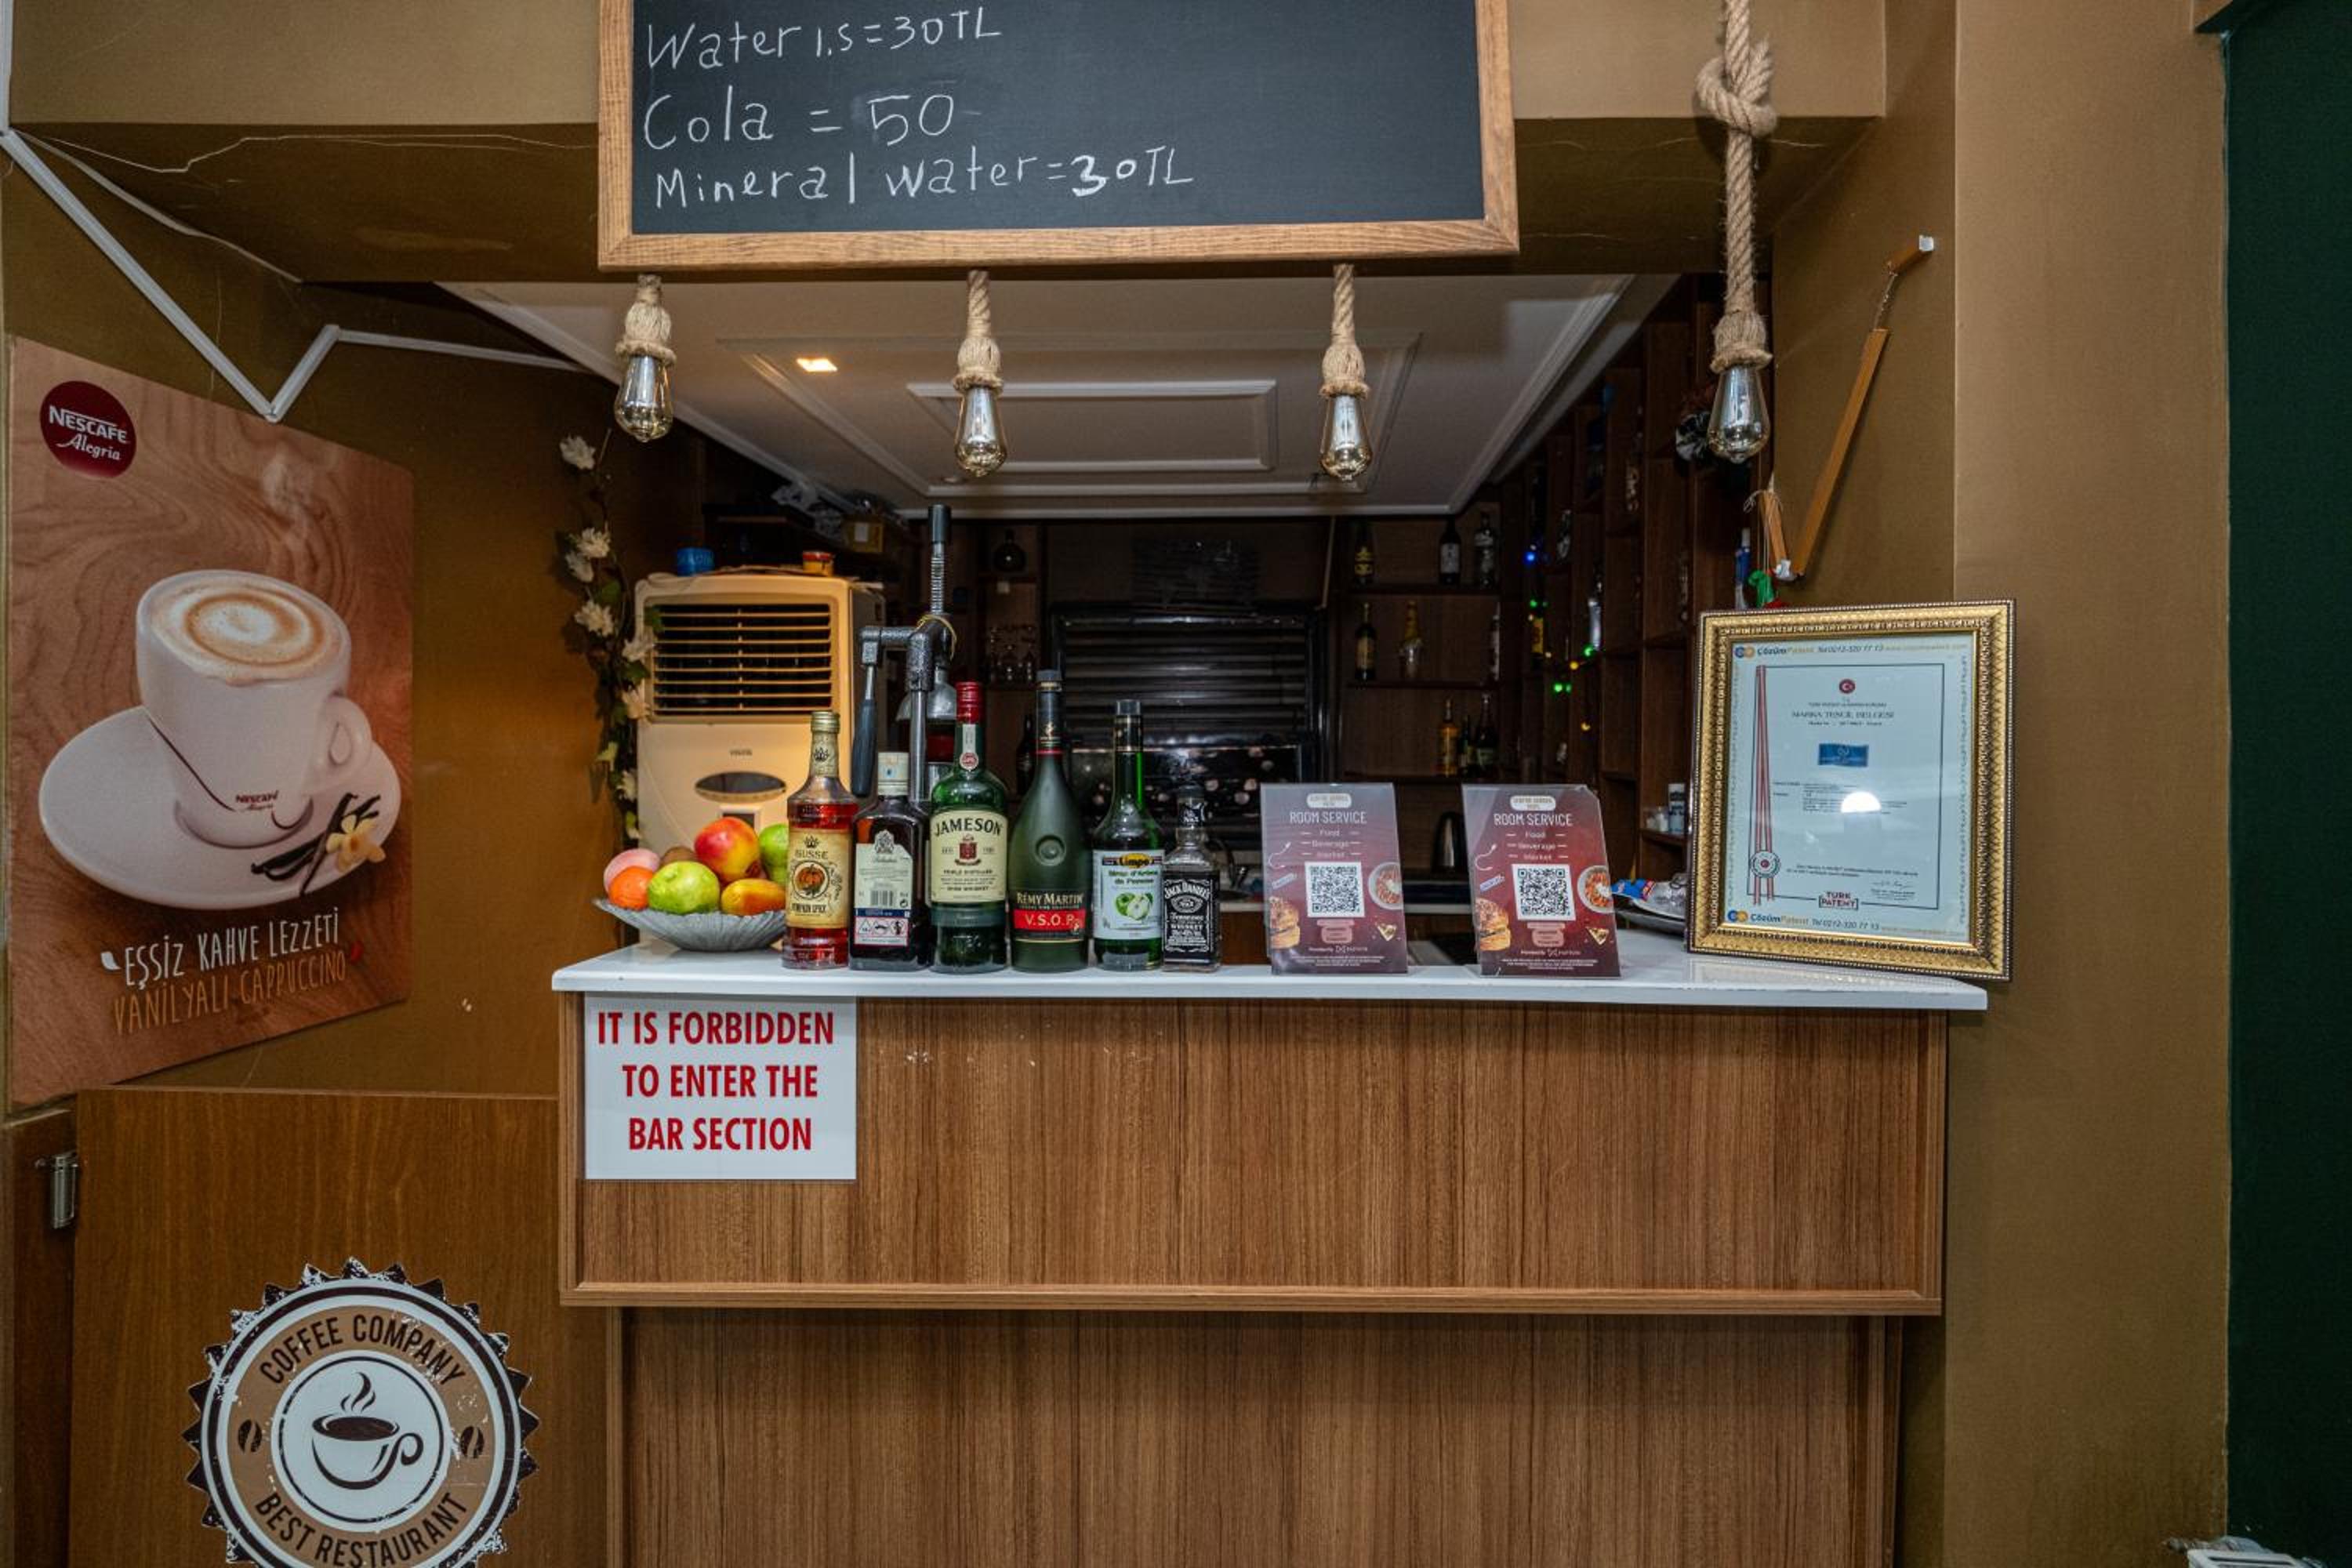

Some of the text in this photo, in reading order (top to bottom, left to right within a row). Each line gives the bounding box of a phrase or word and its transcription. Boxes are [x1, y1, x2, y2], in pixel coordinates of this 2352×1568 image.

[648, 20, 802, 70] Water
[644, 85, 774, 151] Cola
[867, 94, 954, 146] 50
[656, 151, 856, 209] Mineral
[56, 434, 122, 461] Alegria
[934, 817, 1004, 837] JAMESON
[1289, 810, 1368, 825] ROOM SERVICE
[1493, 812, 1573, 827] ROOM SERVICE
[1043, 892, 1084, 905] MARTIN
[125, 906, 339, 991] EŞSİZ KAHVE LEZZETİ
[240, 949, 347, 1004] CAPPUCCINO
[597, 1011, 833, 1044] IT IS FORBIDDEN
[622, 1064, 818, 1097] TO ENTER THE
[629, 1117, 811, 1150] BAR SECTION
[260, 1314, 466, 1385] COFFEE COMPANY
[255, 1492, 467, 1568] BEST RESTAURANT
